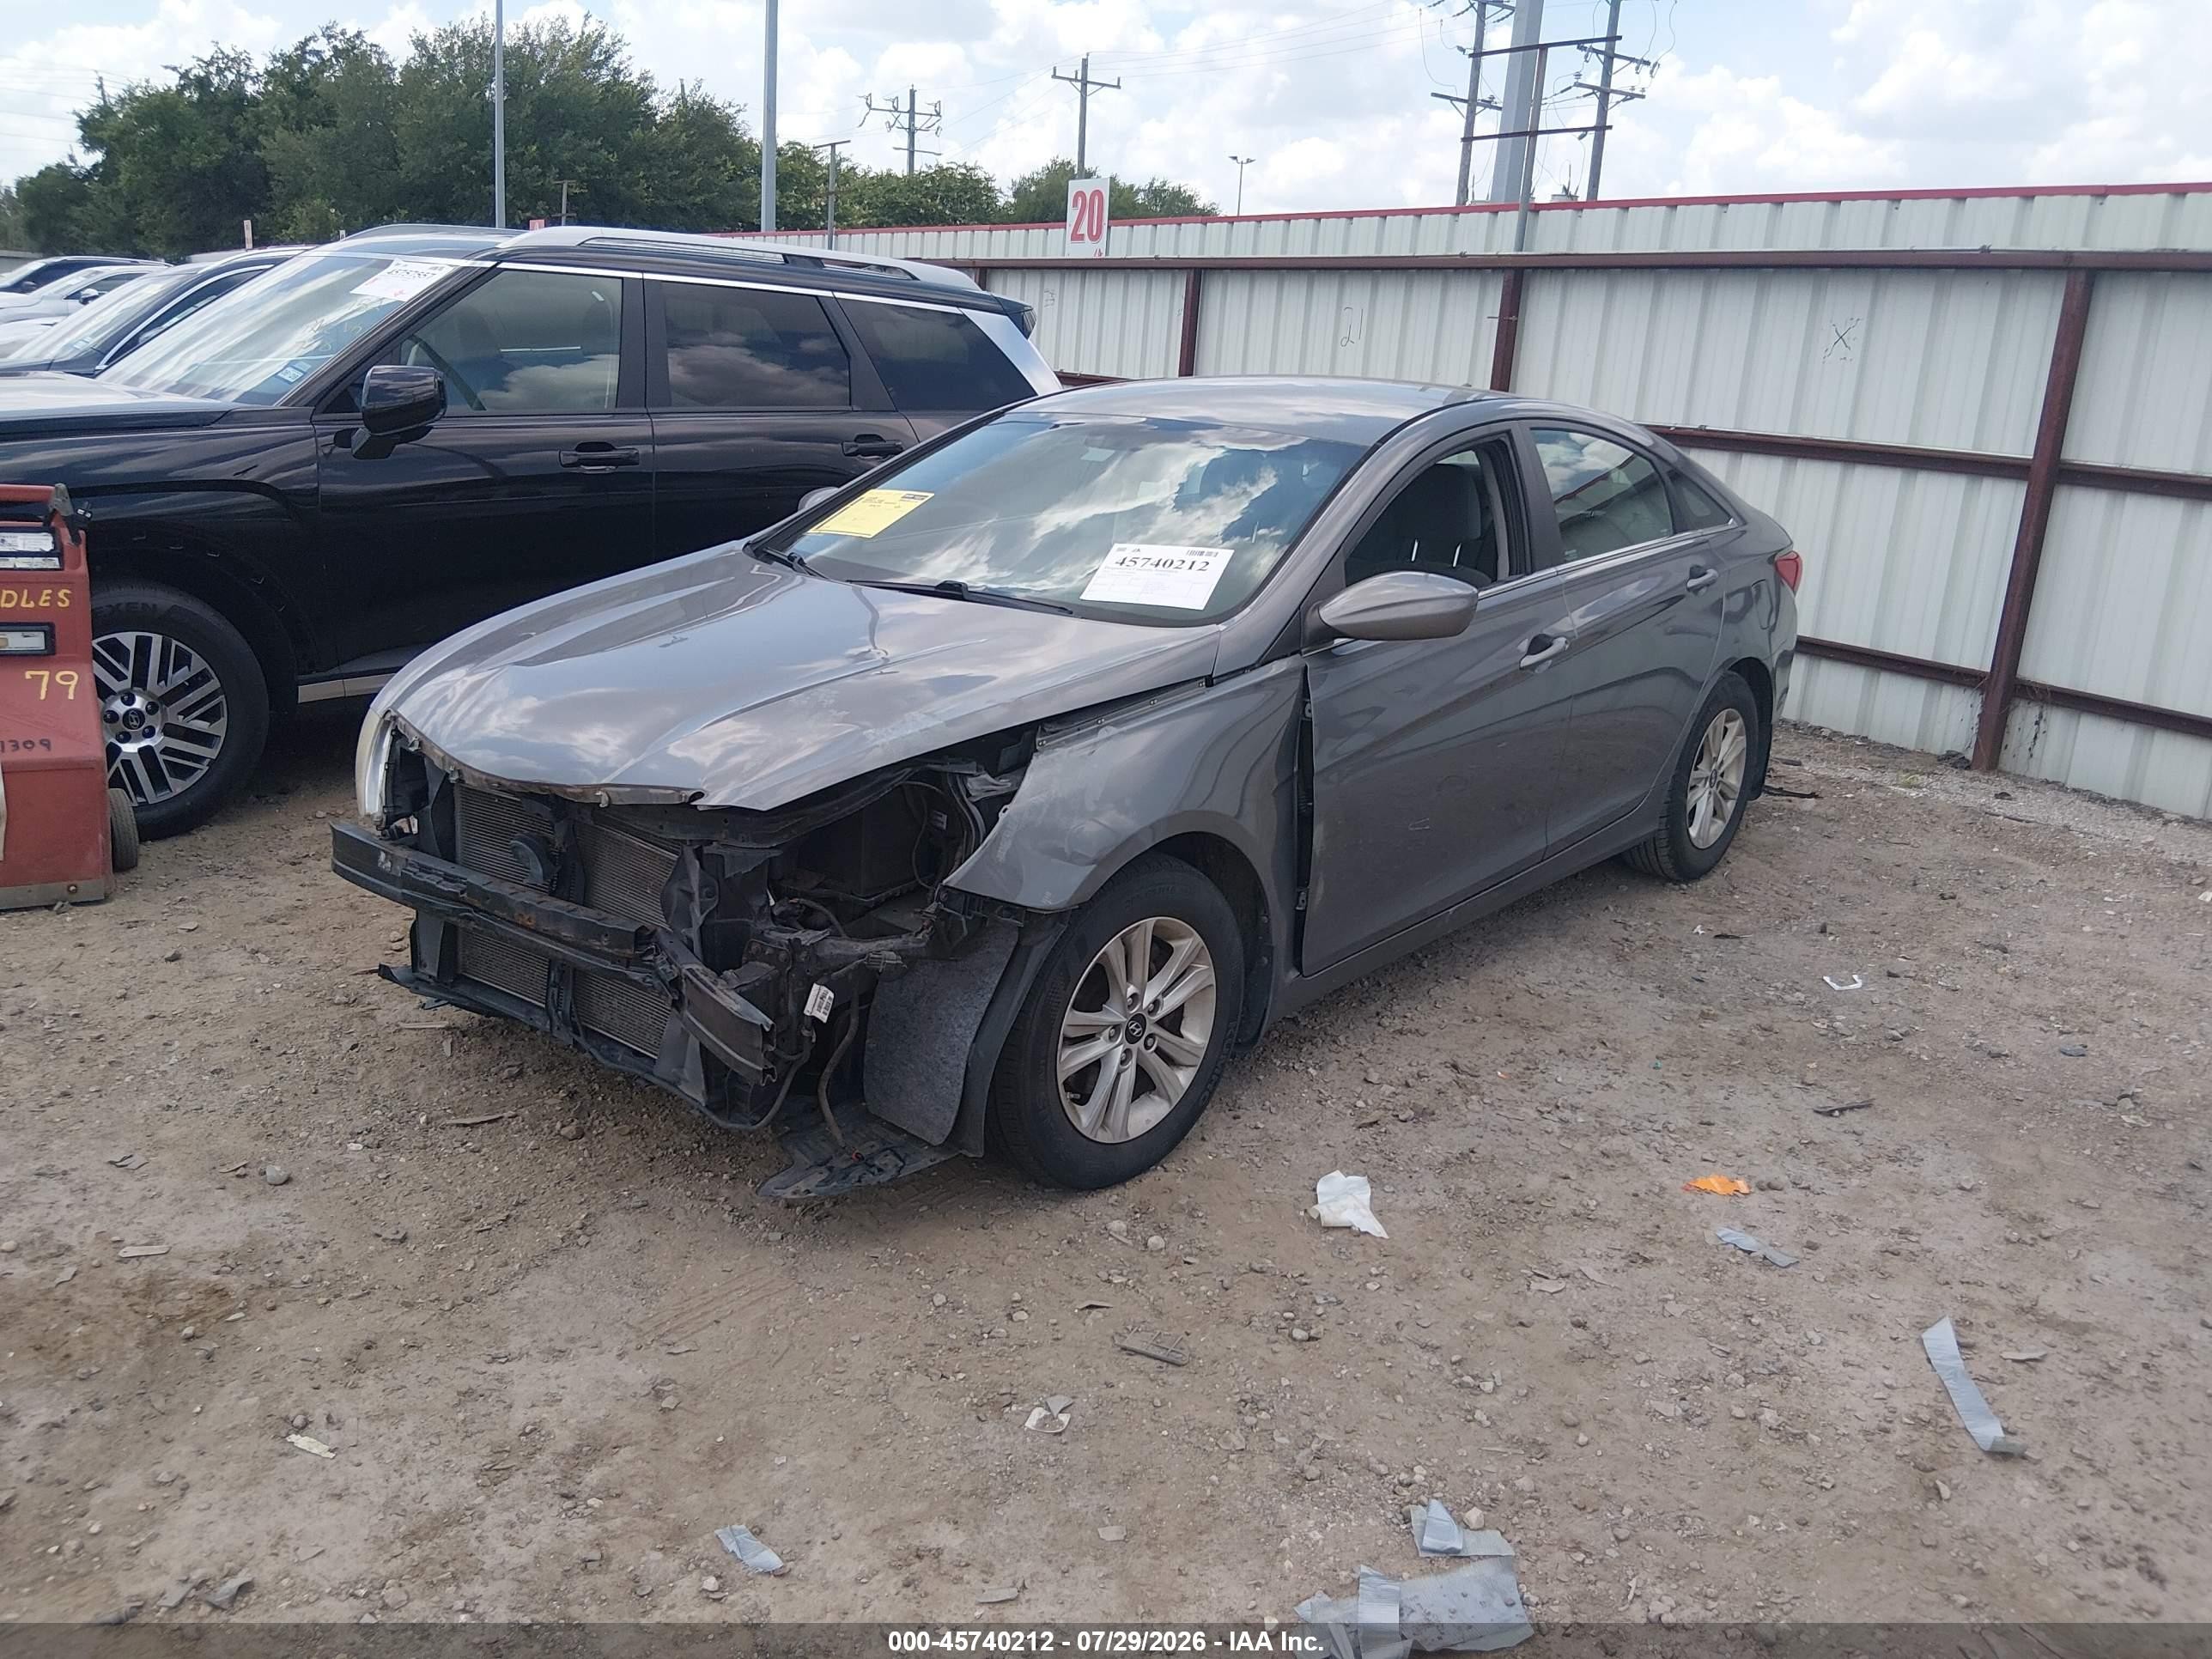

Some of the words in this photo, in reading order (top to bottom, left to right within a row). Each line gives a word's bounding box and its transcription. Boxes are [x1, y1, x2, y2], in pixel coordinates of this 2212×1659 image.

[1071, 189, 1104, 243] 20
[1115, 556, 1210, 572] 45740212
[0, 588, 72, 608] DLES
[25, 670, 79, 701] 79
